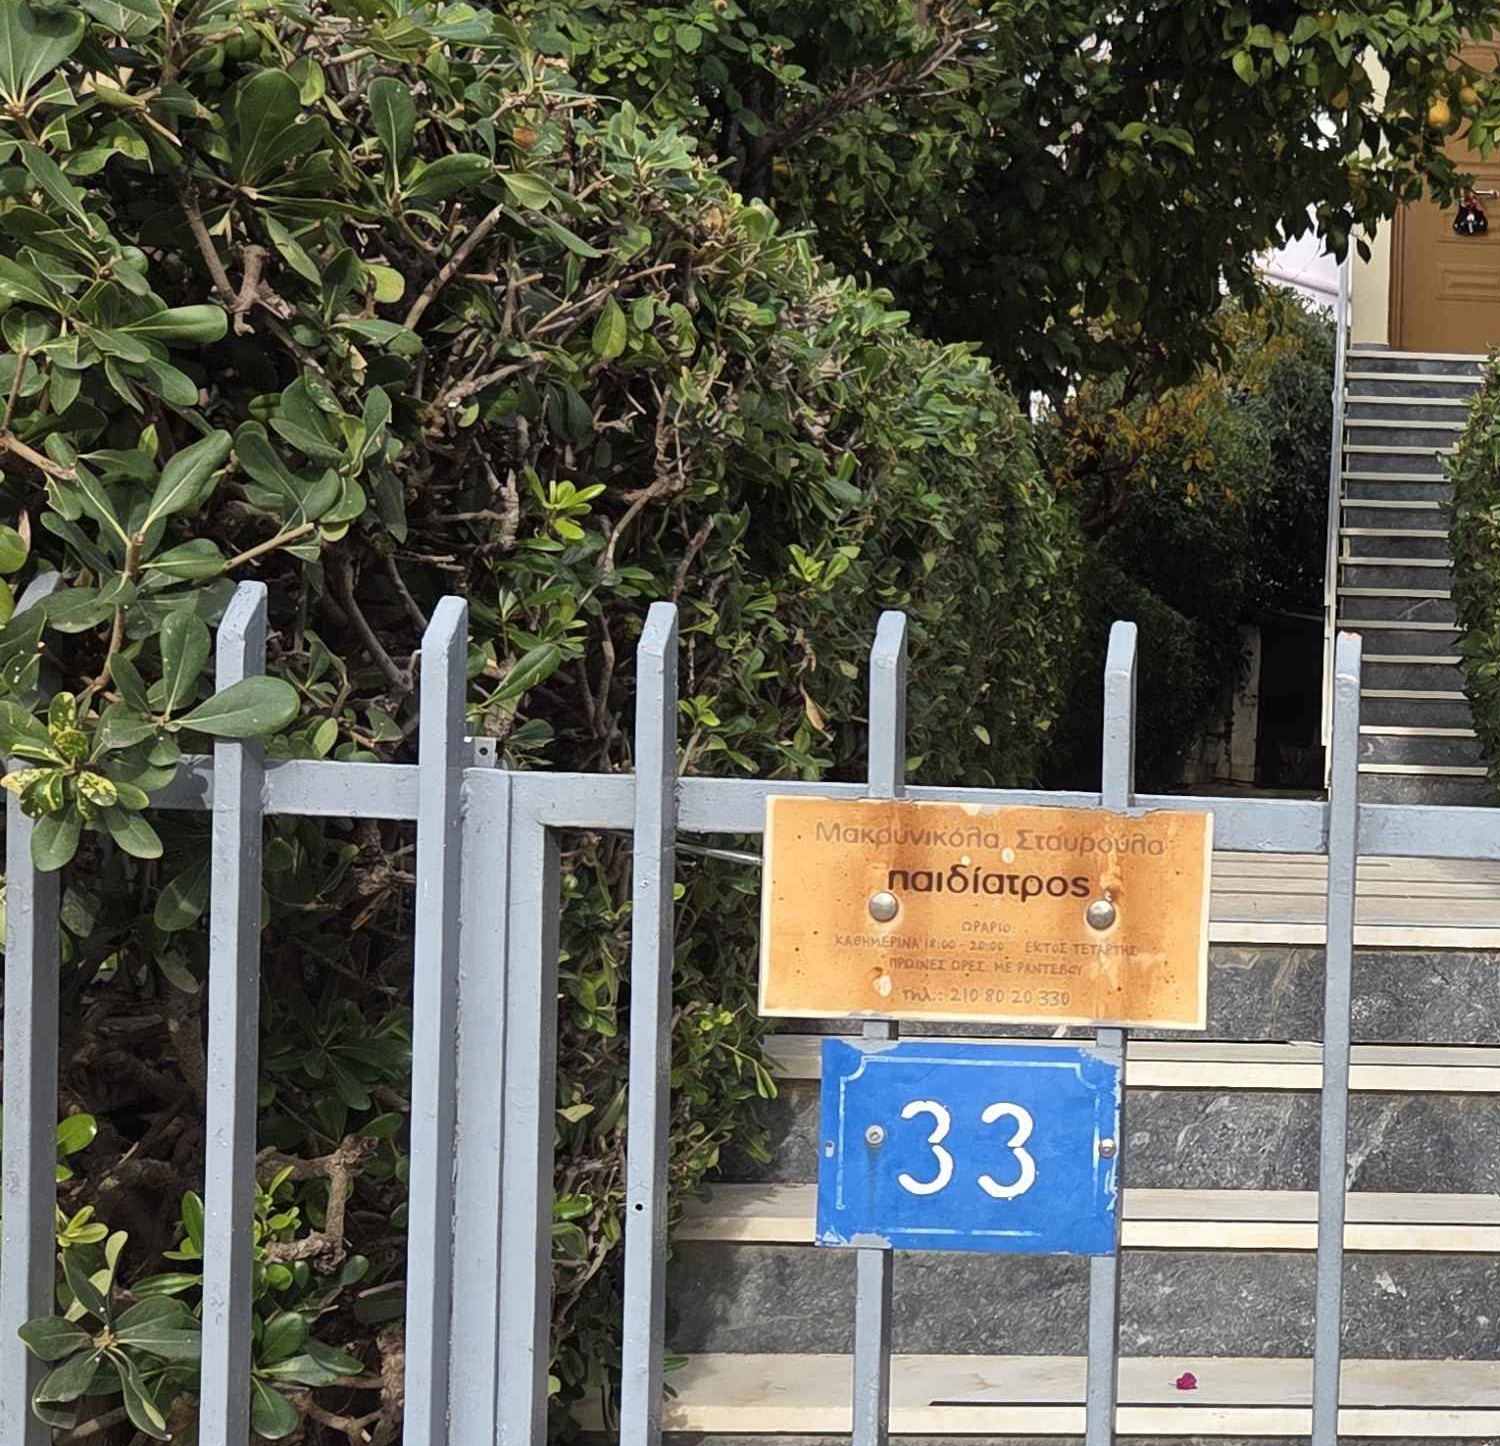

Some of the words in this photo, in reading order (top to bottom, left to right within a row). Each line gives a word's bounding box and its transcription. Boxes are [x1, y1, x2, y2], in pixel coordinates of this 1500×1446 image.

[888, 864, 1090, 902] παιδίατρος
[950, 988, 979, 1003] 210
[985, 988, 1005, 1004] 80
[1011, 989, 1032, 1004] 20
[1038, 990, 1071, 1006] 330
[898, 1100, 1036, 1200] 33
